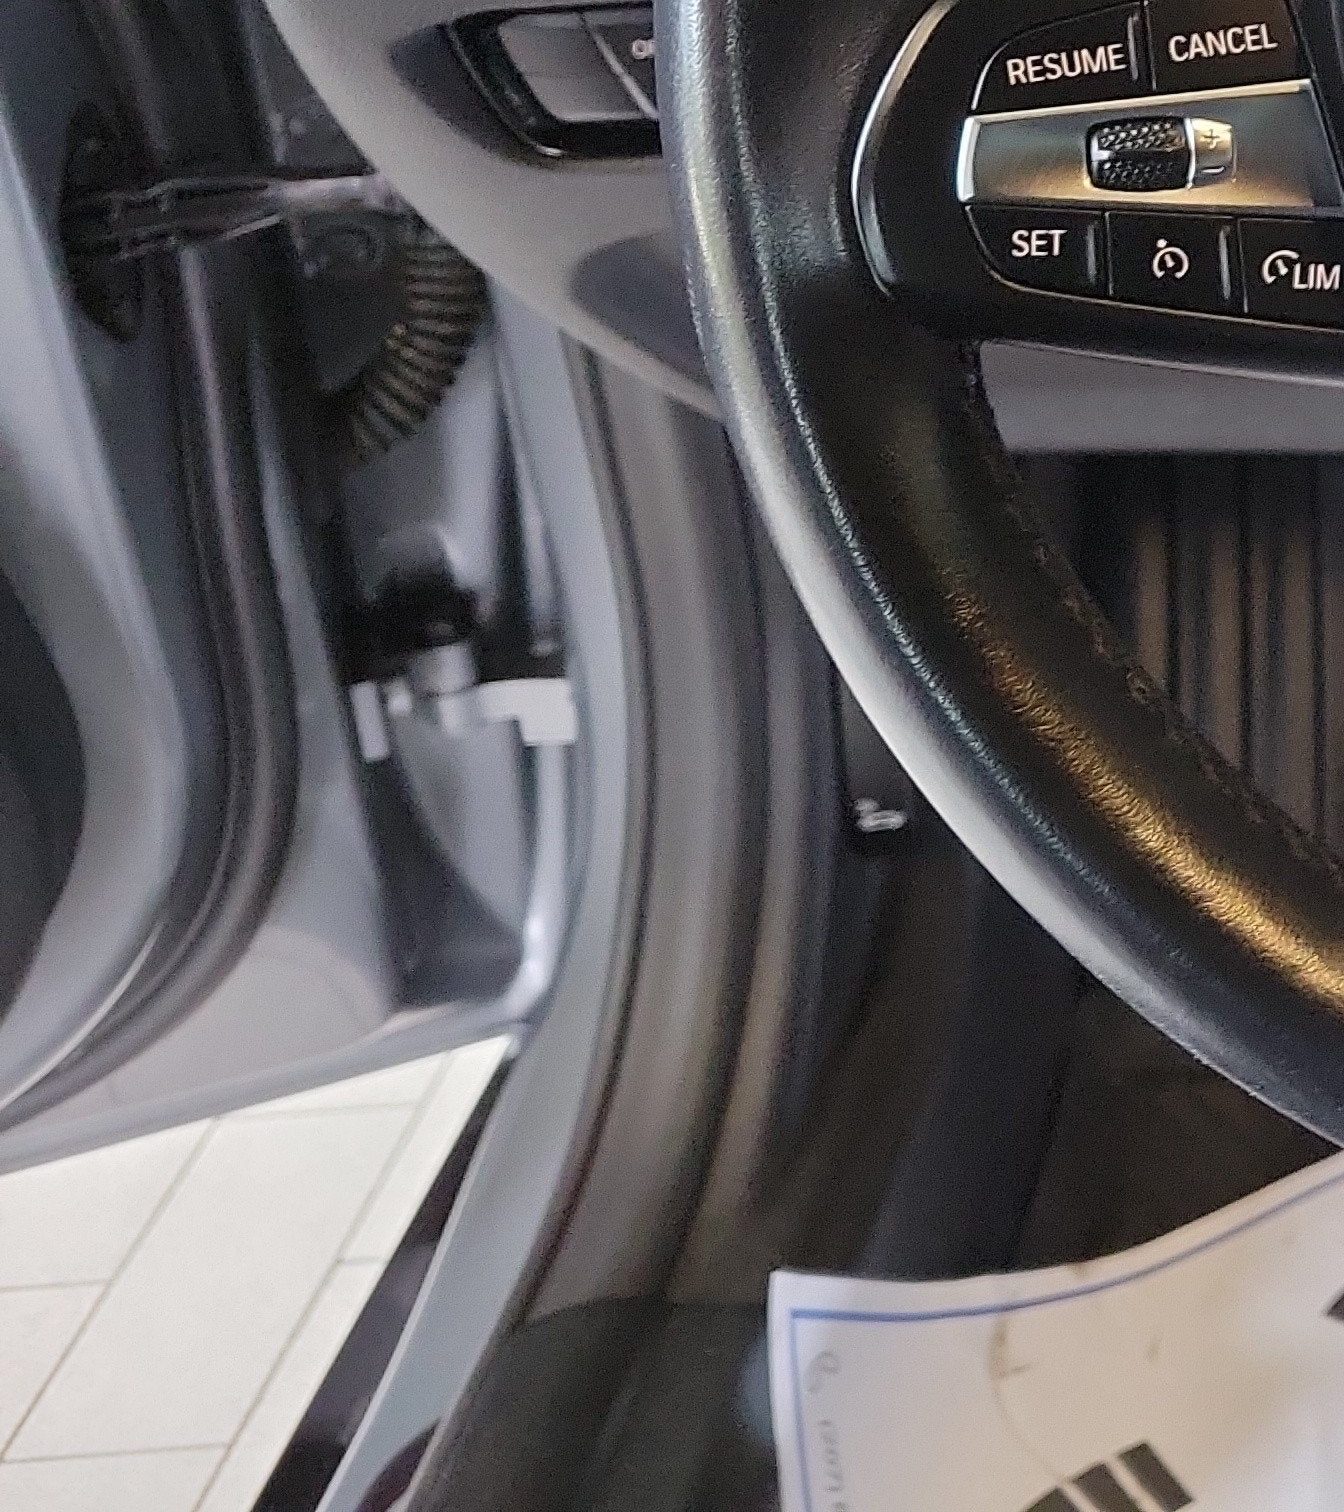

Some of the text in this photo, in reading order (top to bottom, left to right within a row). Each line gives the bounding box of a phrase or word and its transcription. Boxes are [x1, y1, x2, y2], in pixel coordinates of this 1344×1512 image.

[1167, 22, 1279, 63] CANCEL
[1006, 42, 1128, 86] RESUME
[1011, 228, 1068, 258] SET
[1293, 263, 1341, 291] LIM
